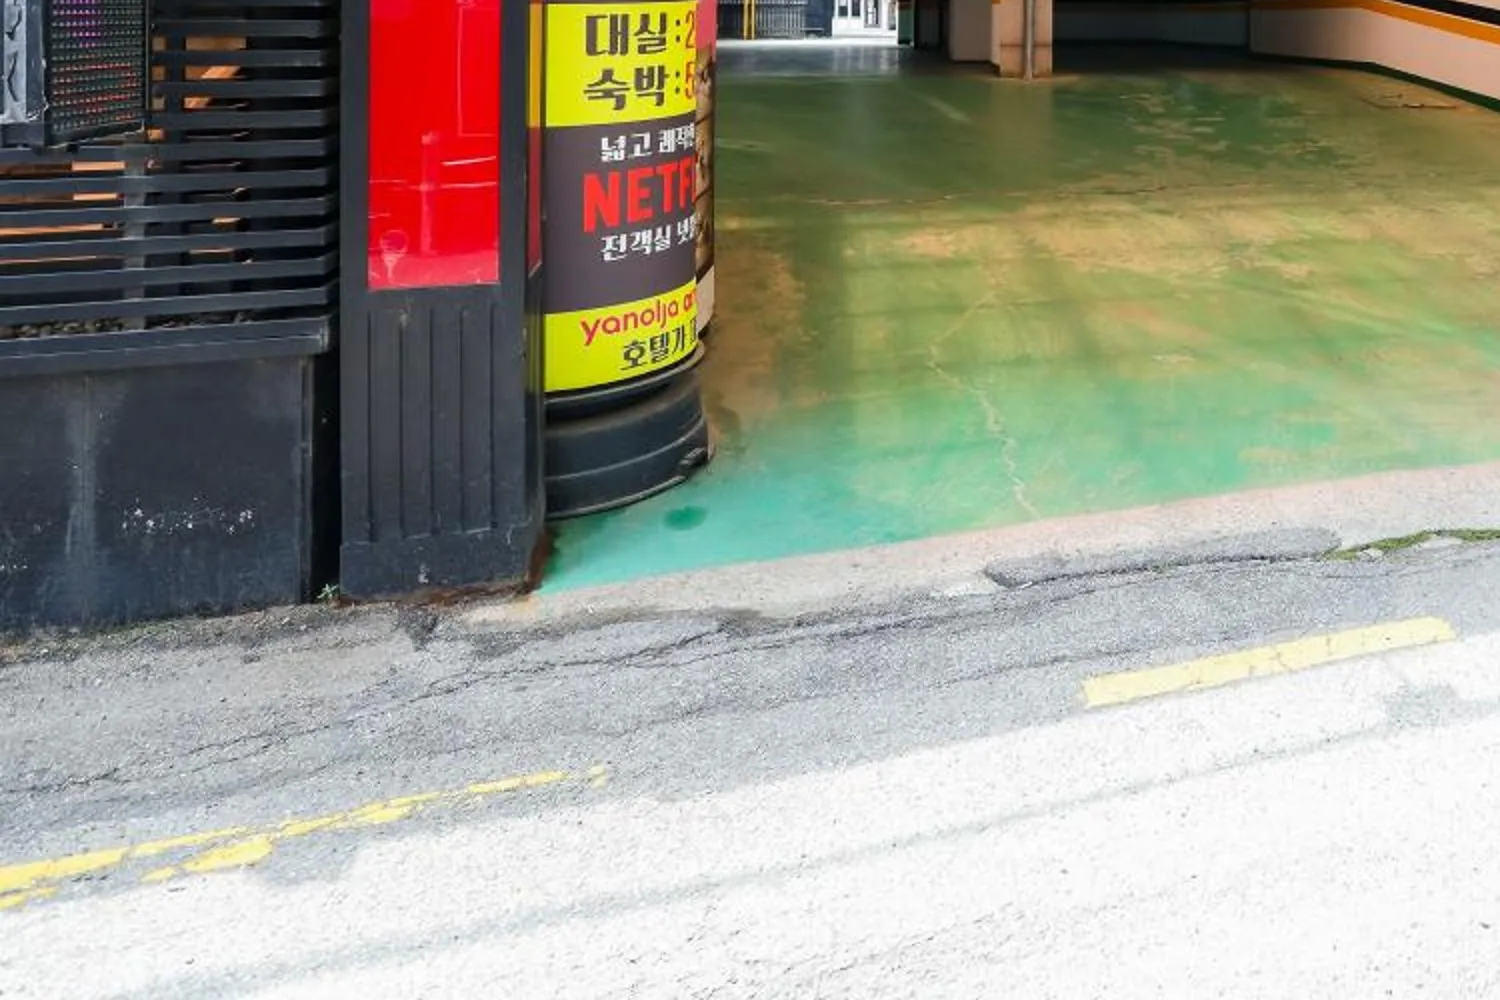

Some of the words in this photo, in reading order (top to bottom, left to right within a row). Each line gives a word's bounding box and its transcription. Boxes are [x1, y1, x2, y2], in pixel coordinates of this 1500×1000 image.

[601, 135, 652, 161] 넓고
[601, 224, 671, 261] 전객실
[580, 299, 678, 346] yanolja
